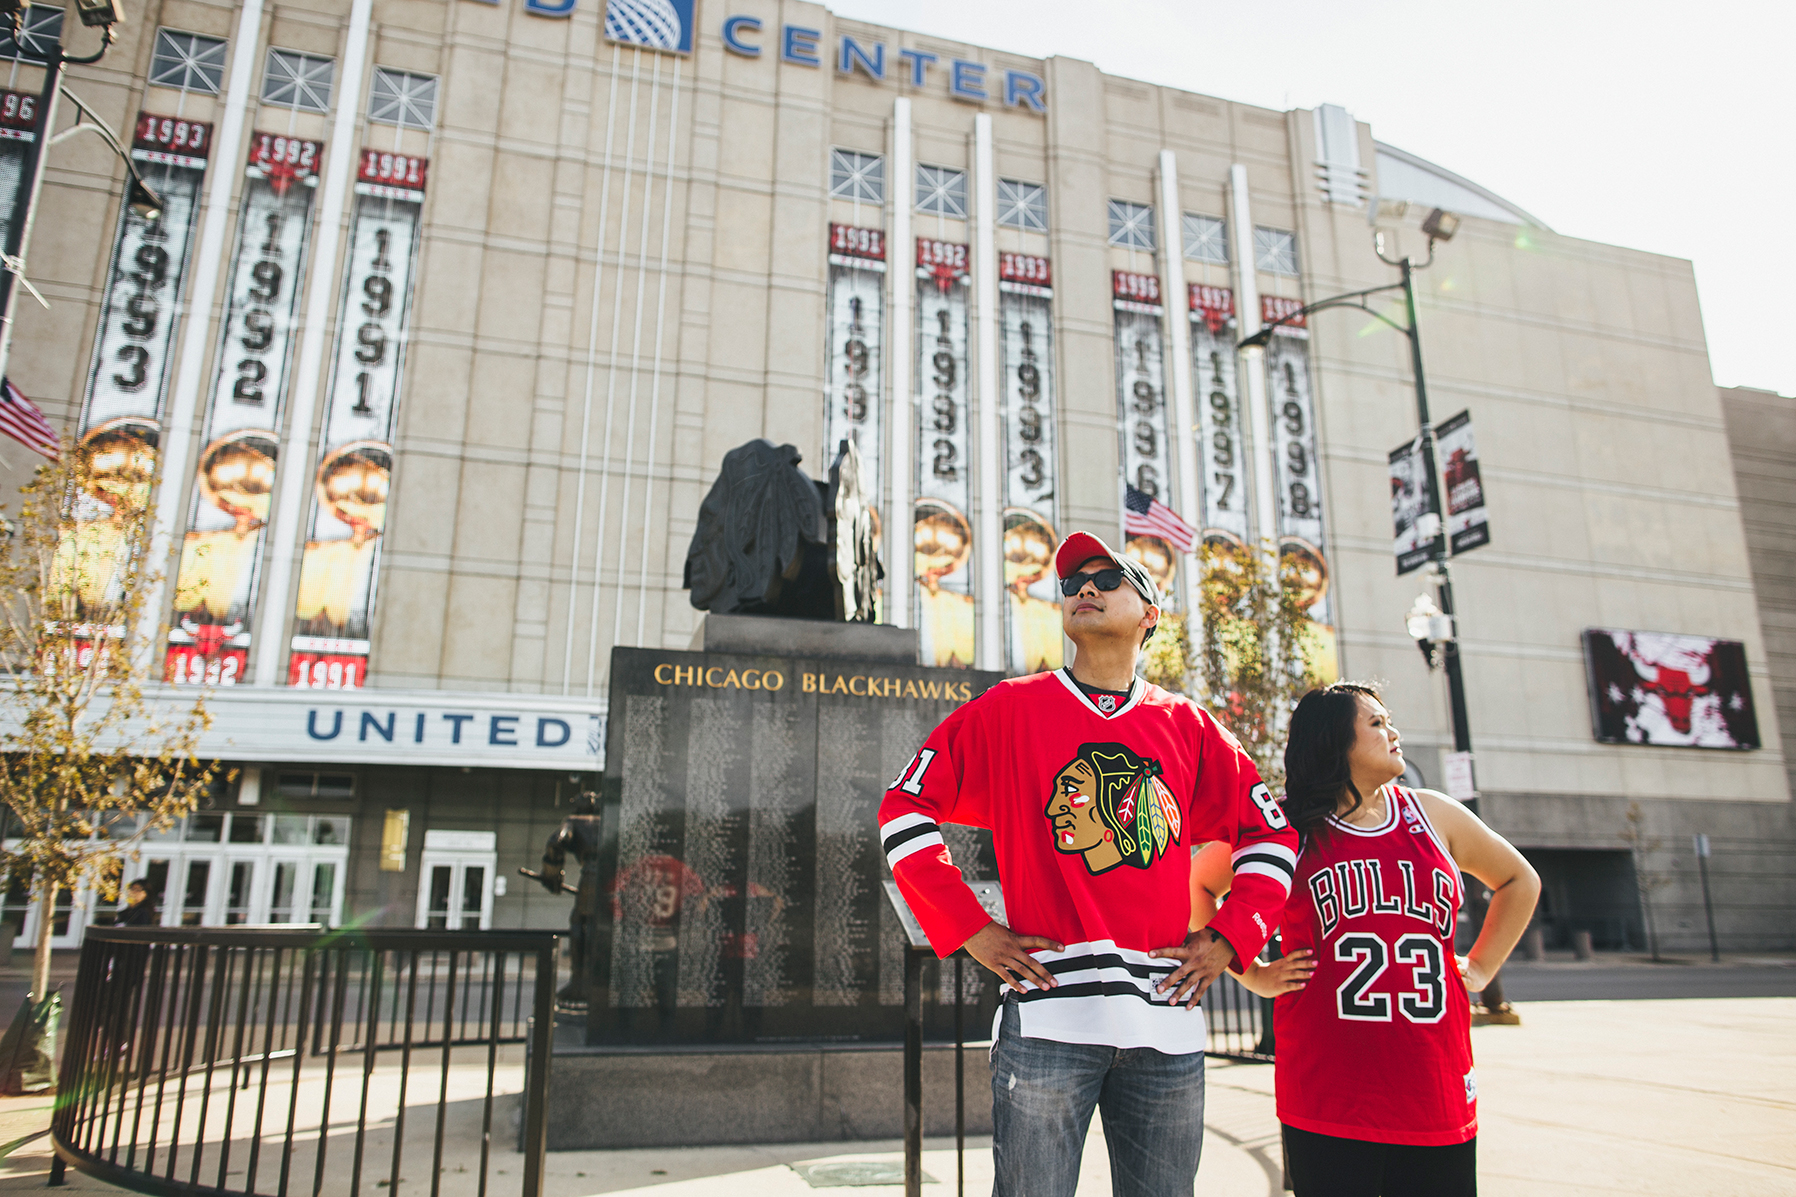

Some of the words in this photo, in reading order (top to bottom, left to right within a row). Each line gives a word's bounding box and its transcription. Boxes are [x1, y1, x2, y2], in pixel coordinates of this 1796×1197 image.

[721, 16, 1047, 111] CENTER
[0, 94, 36, 121] 96
[143, 117, 205, 149] 1993
[257, 135, 316, 167] 1992
[365, 153, 420, 181] 1991
[836, 226, 881, 254] 1991
[921, 240, 966, 266] 1992
[1004, 254, 1047, 279] 1993
[1117, 273, 1159, 299] 1996
[233, 214, 283, 404] 1992
[352, 229, 392, 416] 1991
[933, 309, 956, 480] 1992
[1019, 320, 1043, 490] 1993
[1133, 340, 1159, 498] 1996
[1209, 351, 1236, 511] 1997
[1283, 361, 1310, 516] 1998
[295, 659, 357, 691] 1991
[654, 663, 785, 692] CHICAGO
[802, 673, 973, 702] BLACKHAWKS
[306, 709, 572, 748] UNITED
[1249, 781, 1288, 831] 8
[1308, 859, 1455, 940] BULLS
[1333, 931, 1448, 1024] 23
